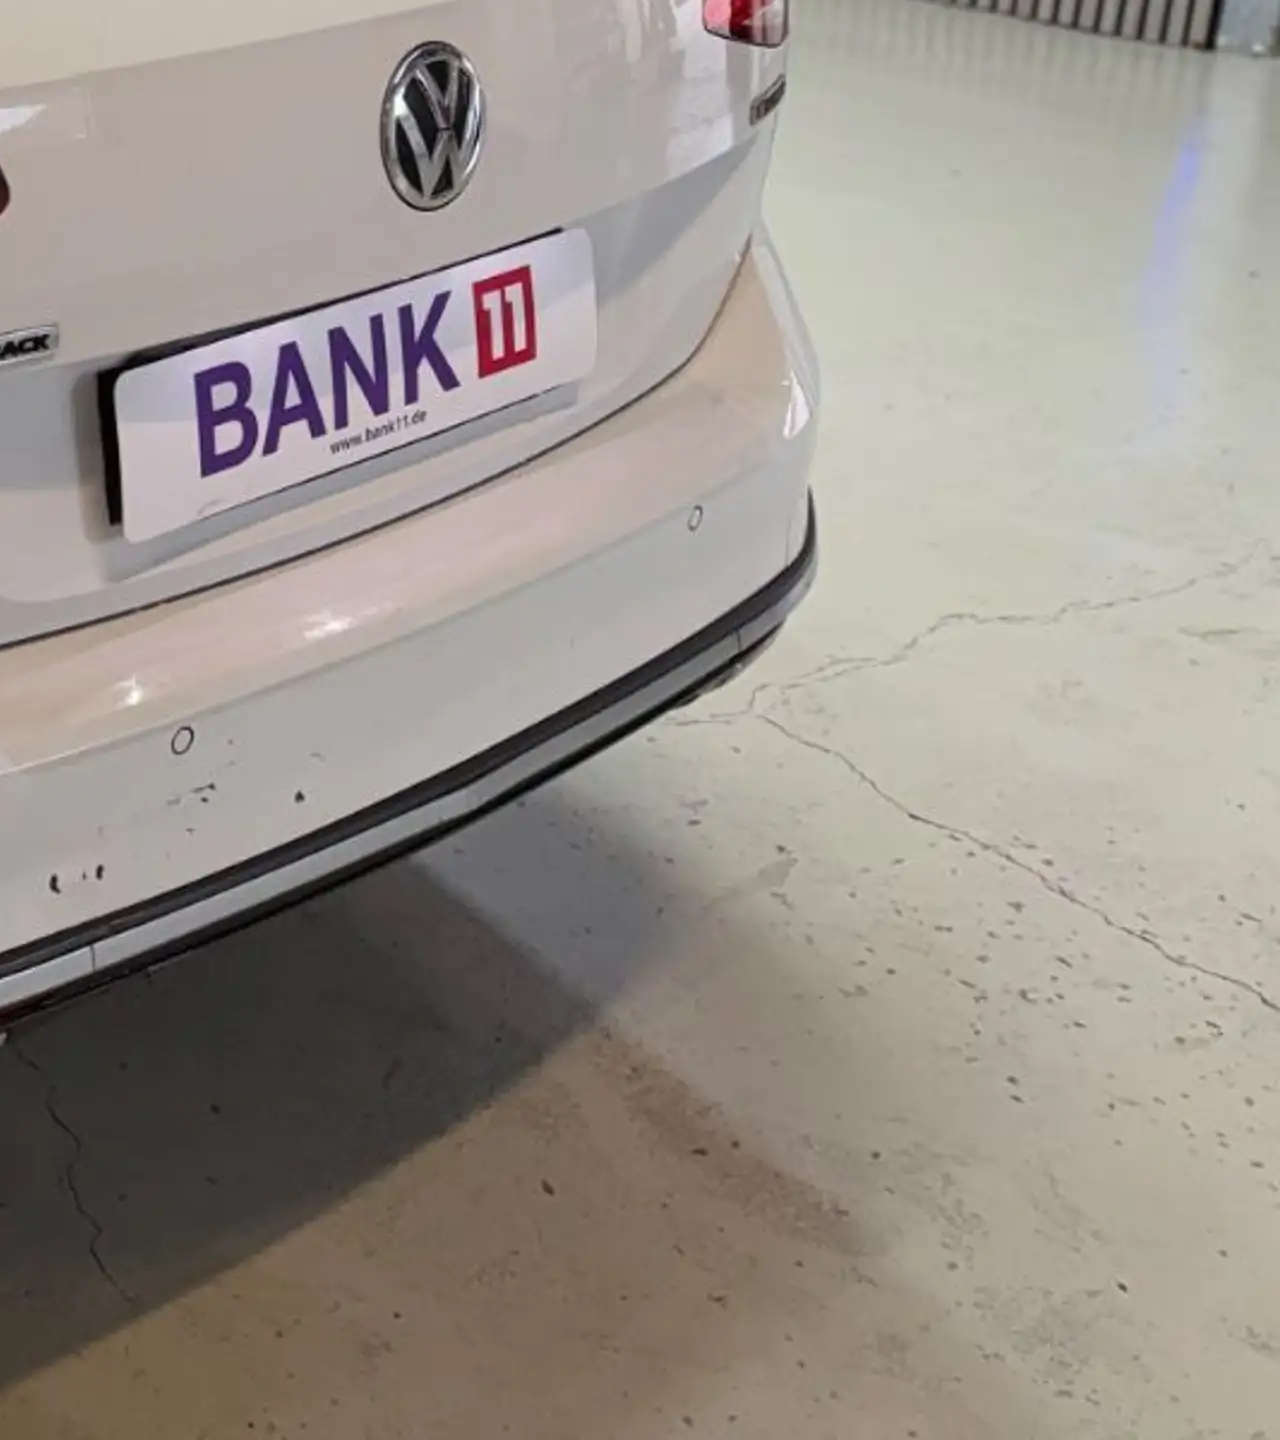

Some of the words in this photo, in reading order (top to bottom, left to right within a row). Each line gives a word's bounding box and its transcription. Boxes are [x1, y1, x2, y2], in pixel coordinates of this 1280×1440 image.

[194, 290, 461, 479] BANK
[480, 279, 528, 363] 11
[329, 408, 428, 455] www.bank11.de
